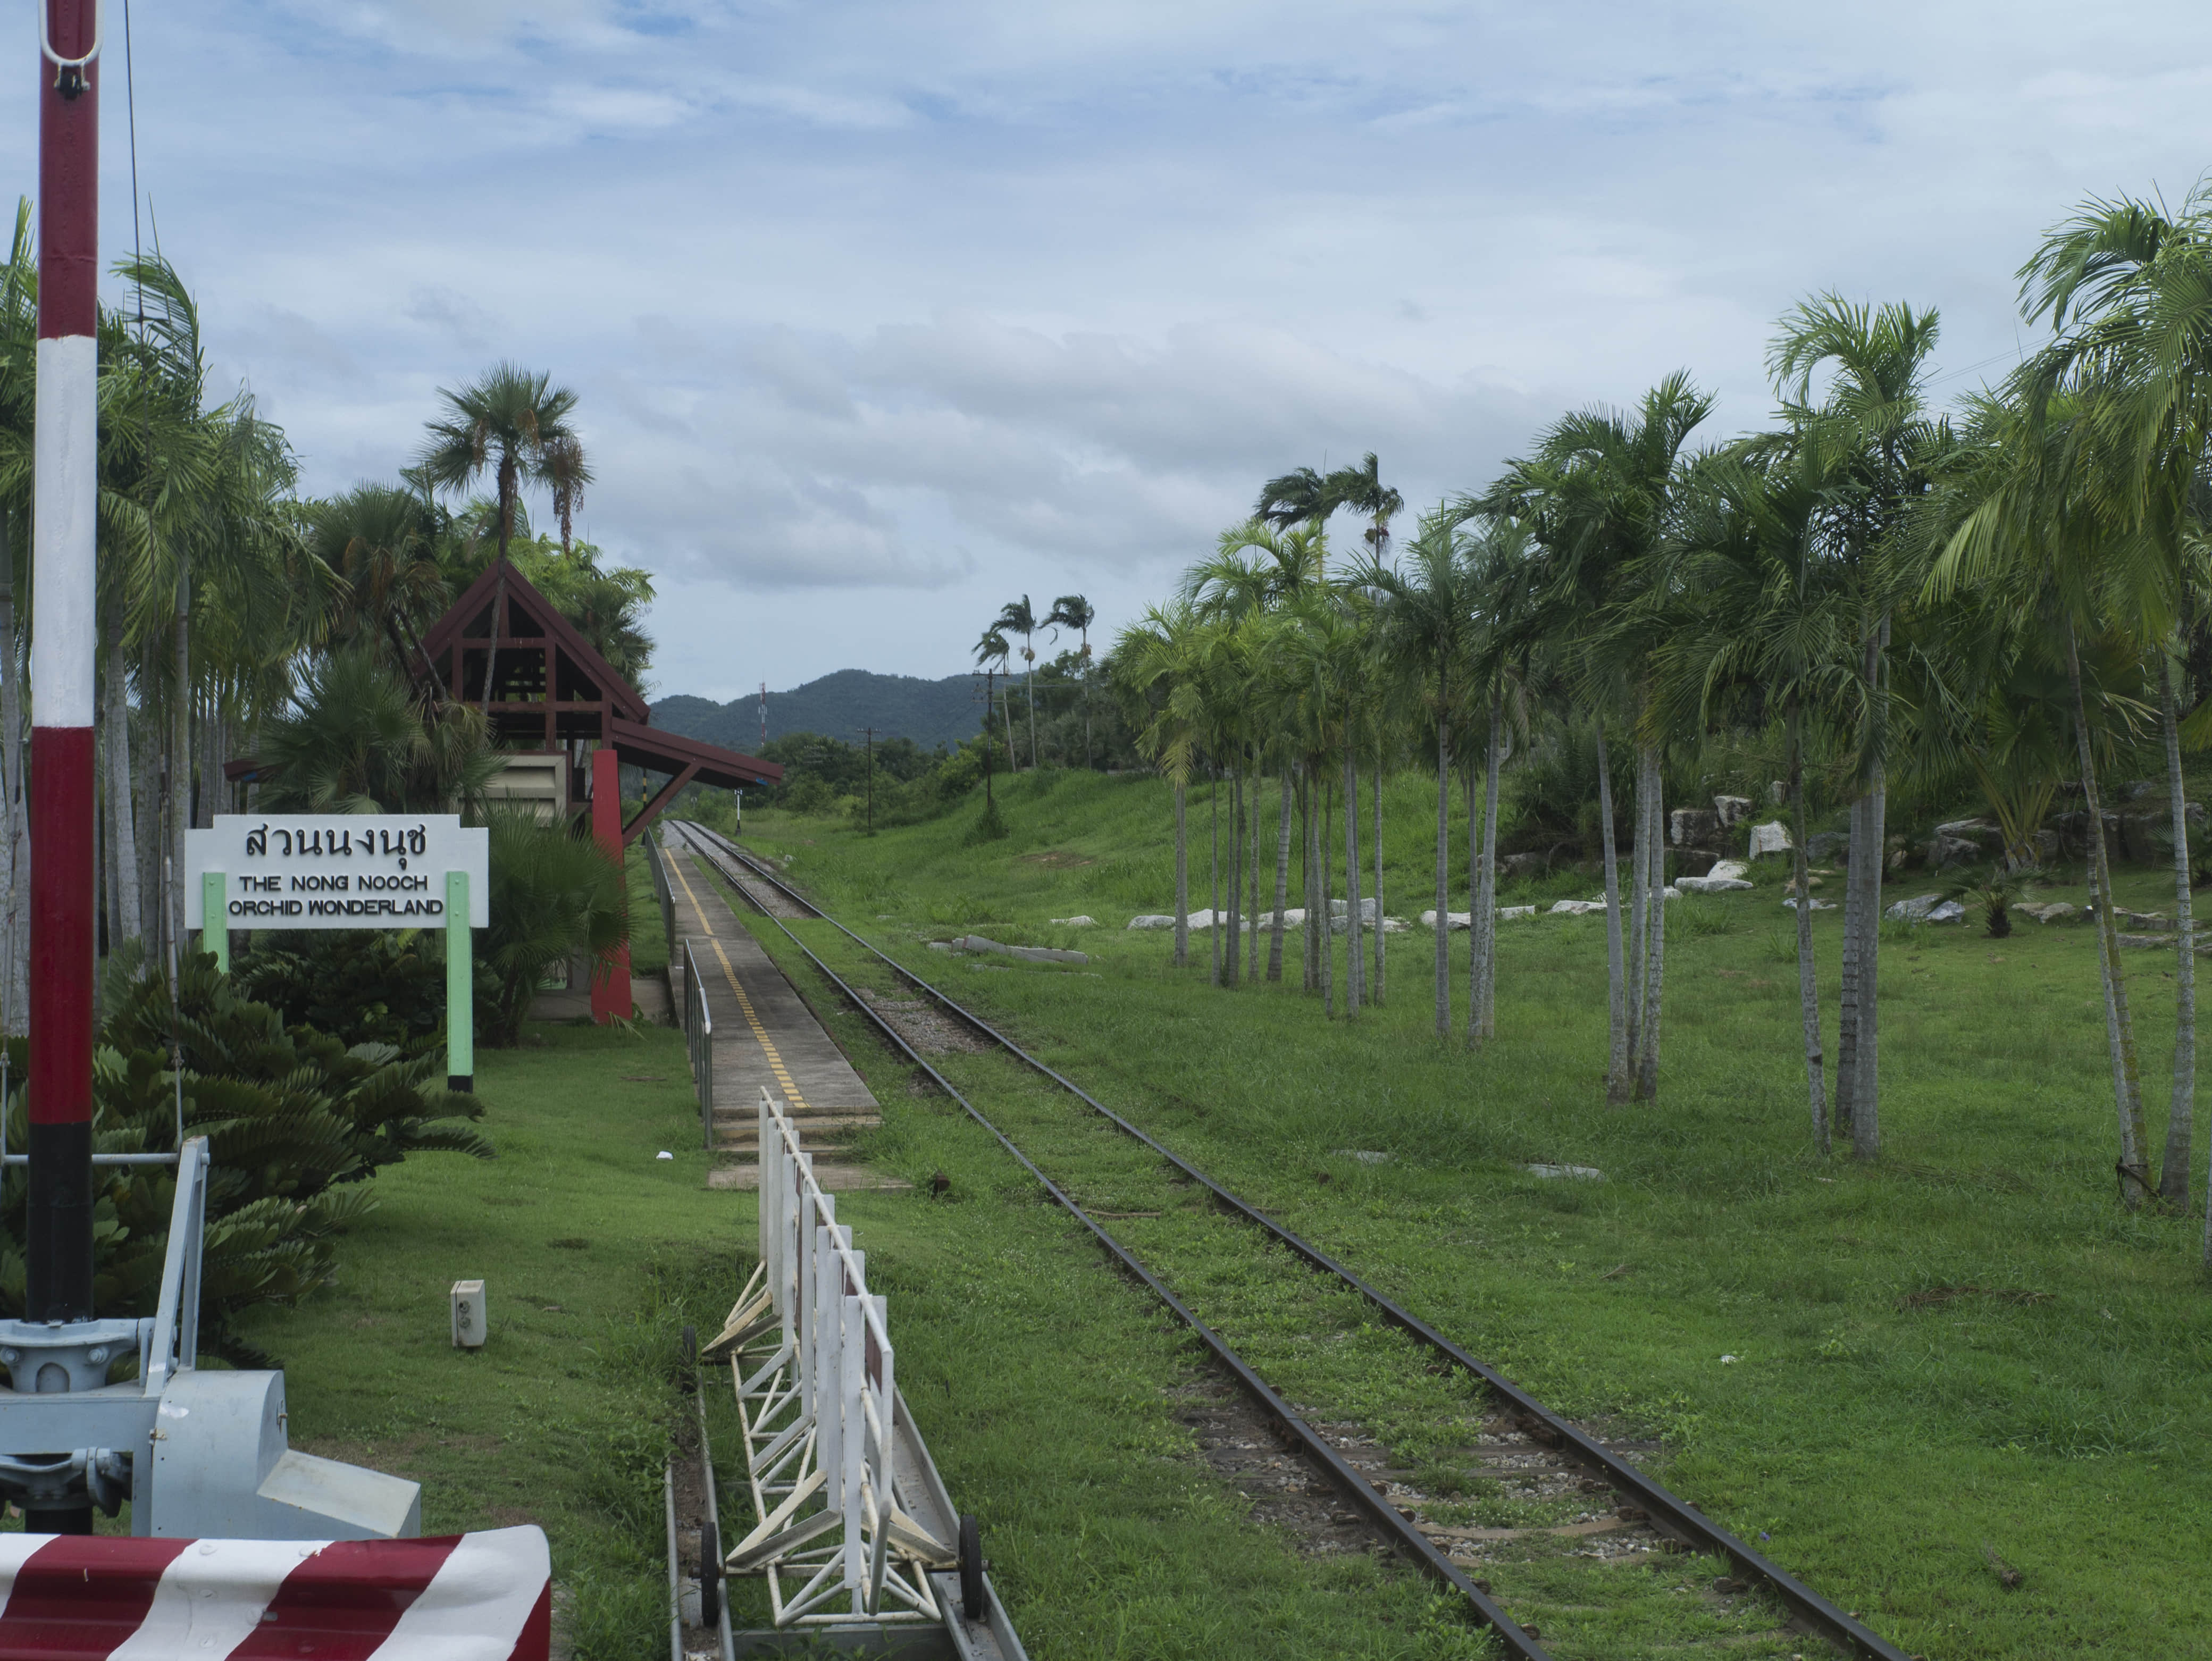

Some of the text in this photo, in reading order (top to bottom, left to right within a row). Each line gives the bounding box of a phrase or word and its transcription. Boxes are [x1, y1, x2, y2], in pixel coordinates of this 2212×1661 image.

[246, 823, 426, 871] สวนนงนุช
[239, 875, 428, 892] THE NONG NOOCH
[229, 900, 443, 916] ORCHID WONDERLAND
